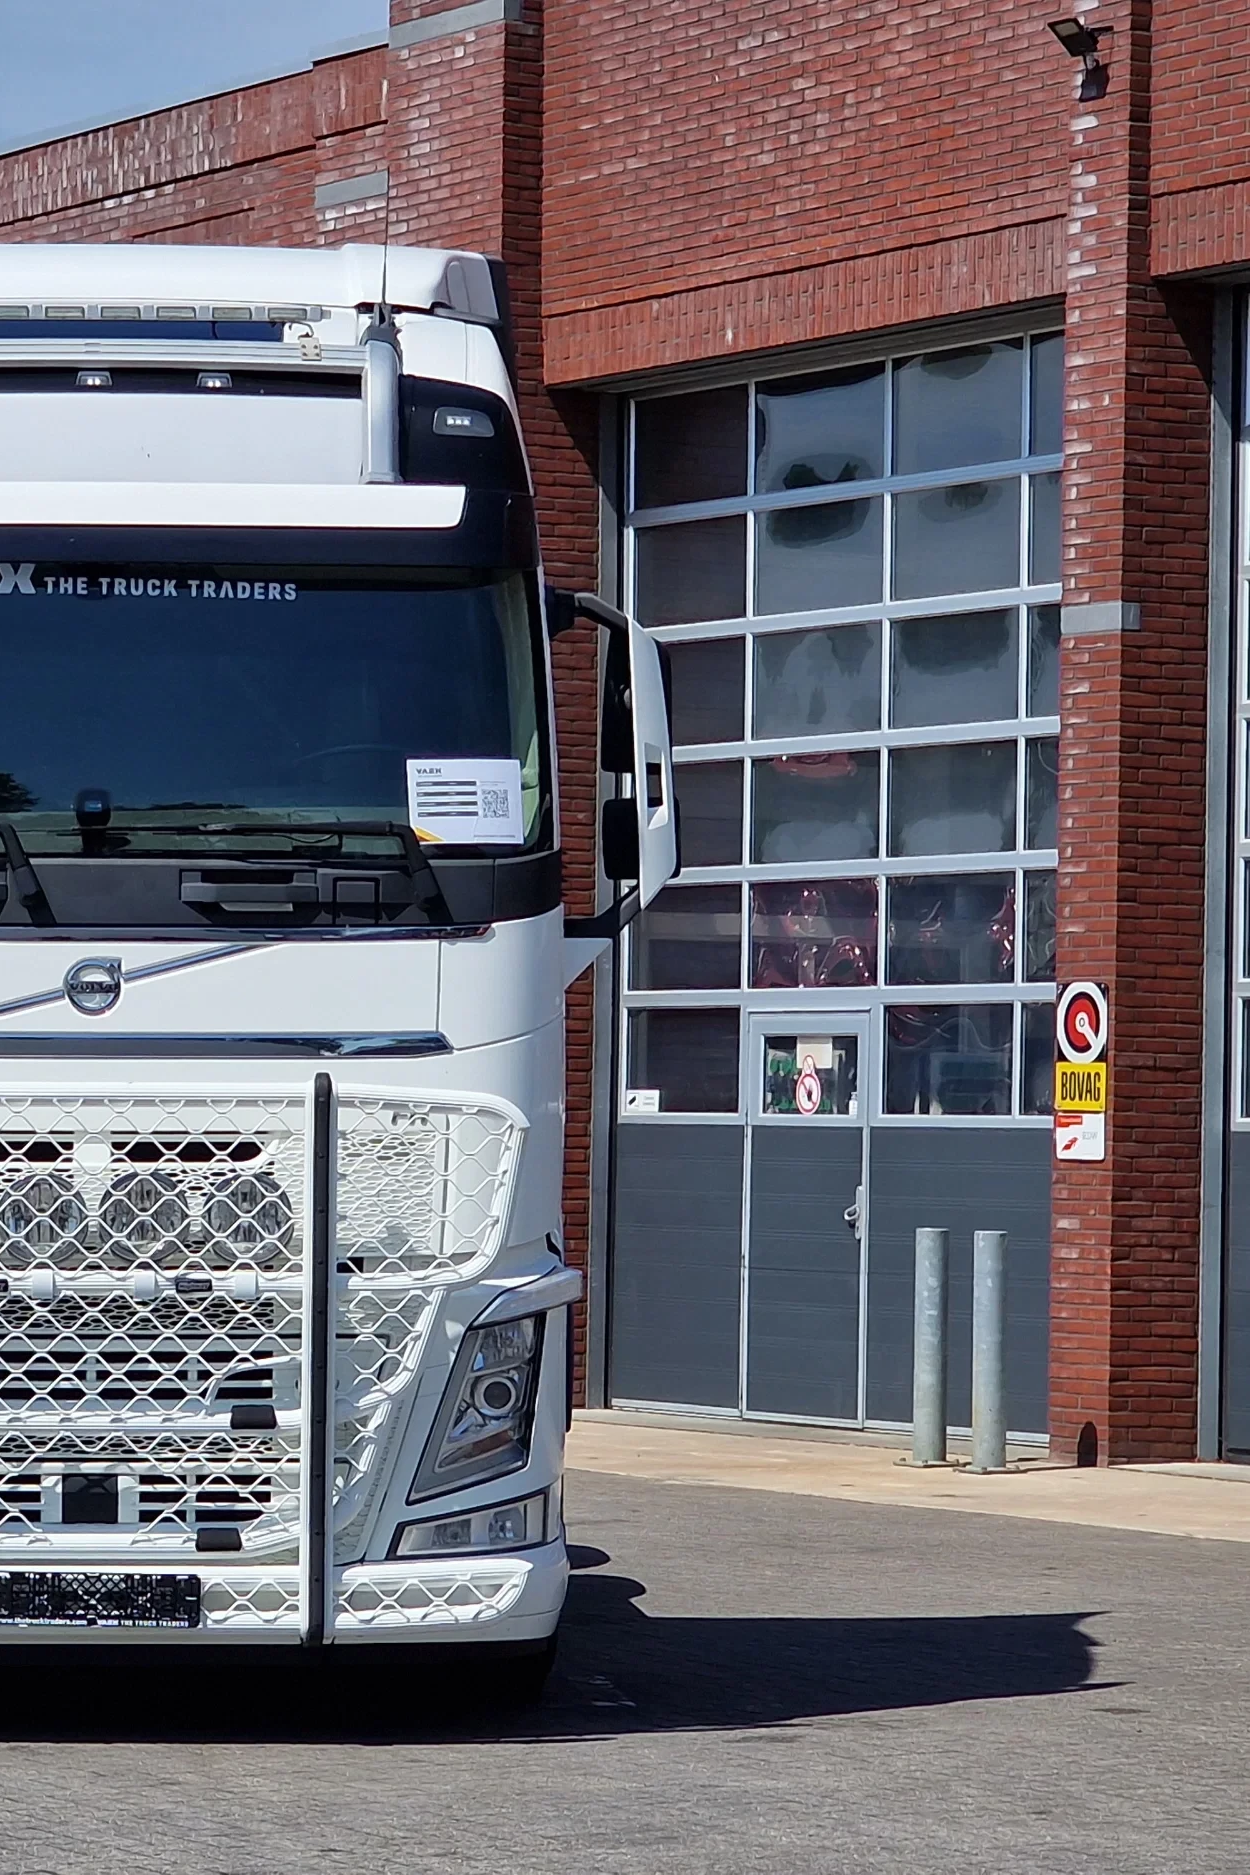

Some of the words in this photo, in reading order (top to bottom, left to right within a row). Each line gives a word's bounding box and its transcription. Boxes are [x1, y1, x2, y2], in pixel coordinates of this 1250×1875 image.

[43, 577, 88, 595] THE
[98, 577, 178, 597] TRUCK
[187, 580, 297, 600] TRADERS
[1061, 1070, 1101, 1102] BOVAG
